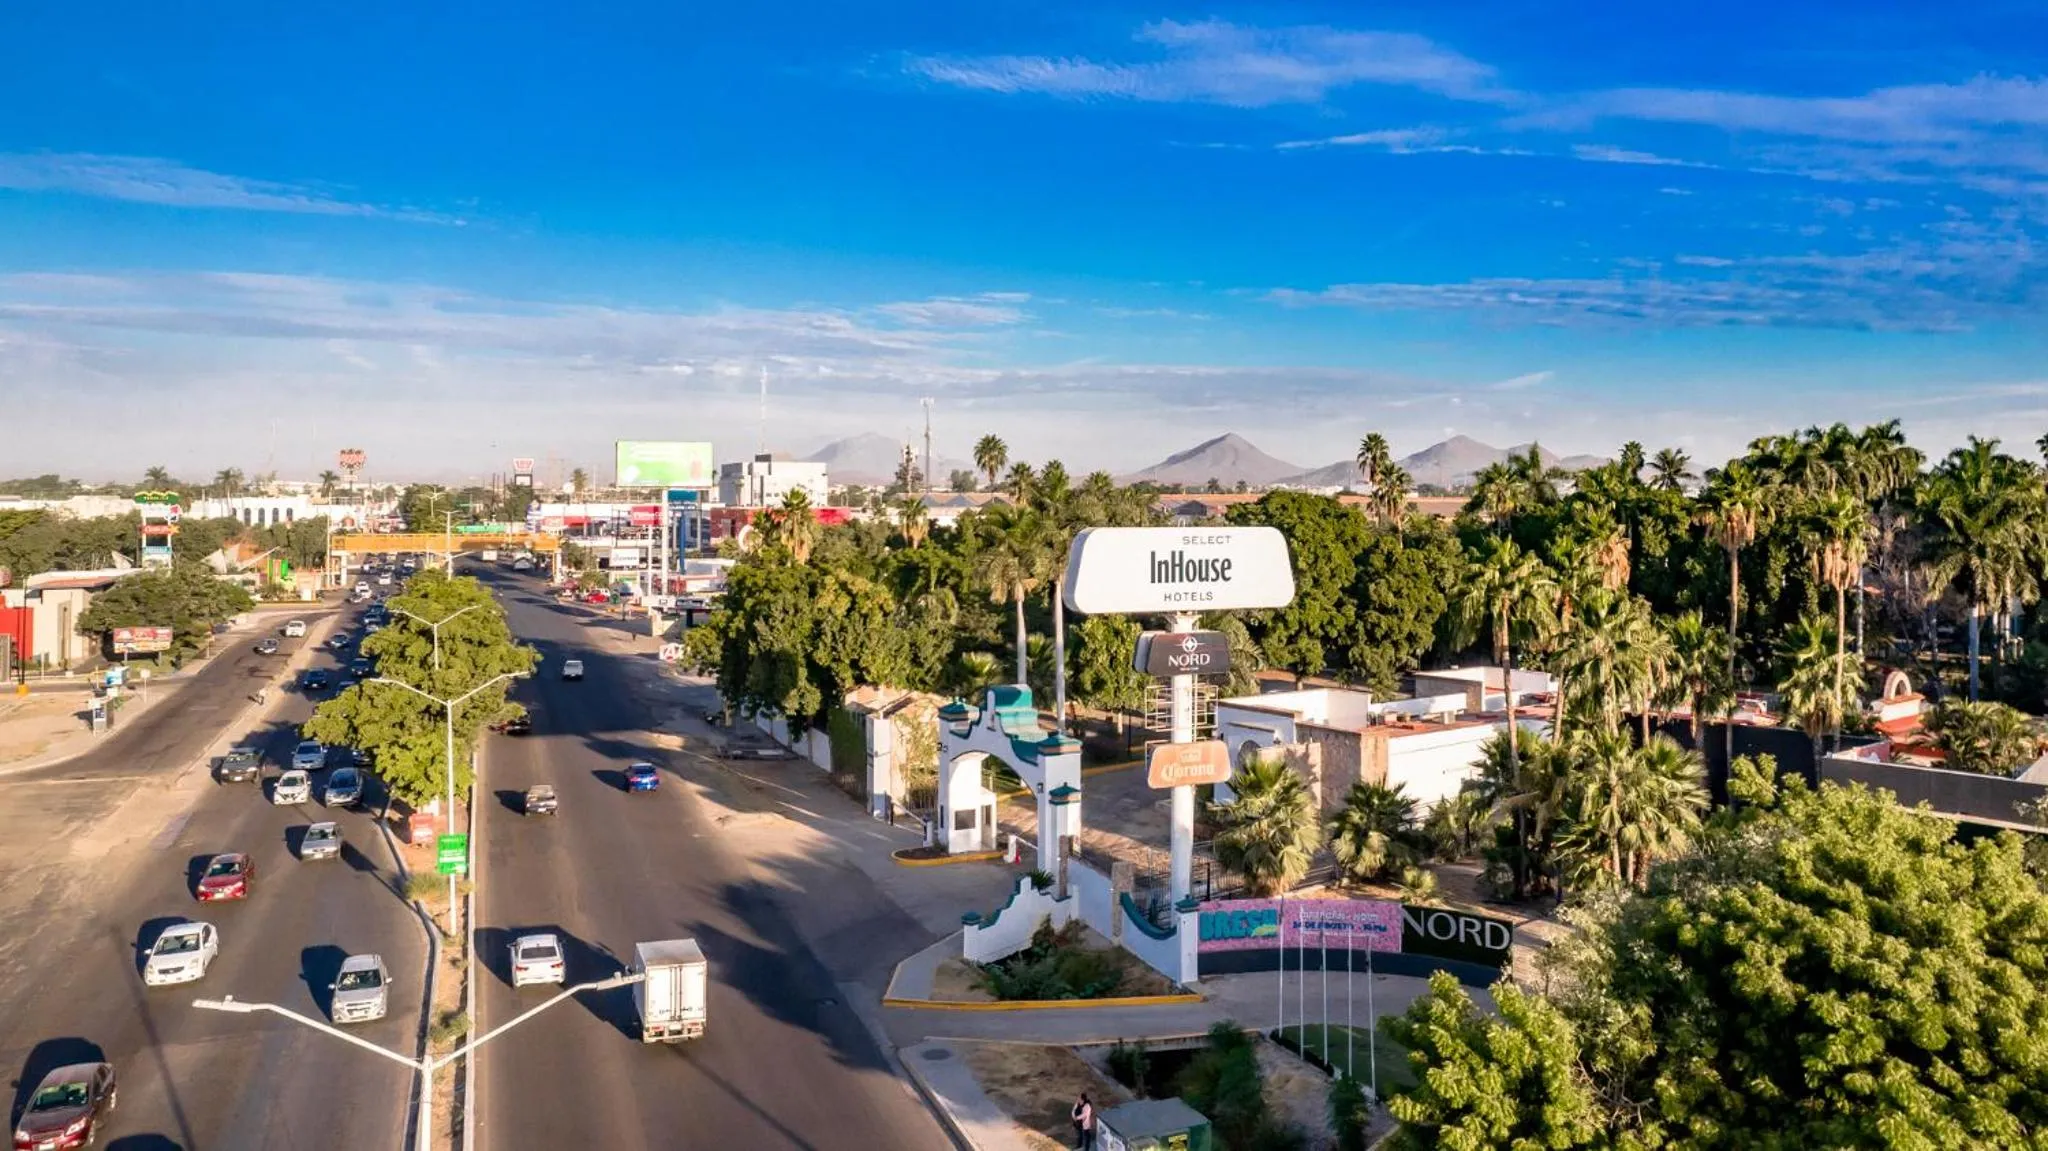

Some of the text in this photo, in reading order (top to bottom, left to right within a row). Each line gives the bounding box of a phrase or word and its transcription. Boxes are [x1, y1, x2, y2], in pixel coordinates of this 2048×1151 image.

[1182, 535, 1232, 545] SELECT
[1150, 550, 1232, 584] InHouse
[1164, 591, 1214, 602] HOTELS
[1168, 653, 1211, 668] NORD
[1160, 761, 1216, 782] Corona
[1400, 905, 1511, 951] NORD
